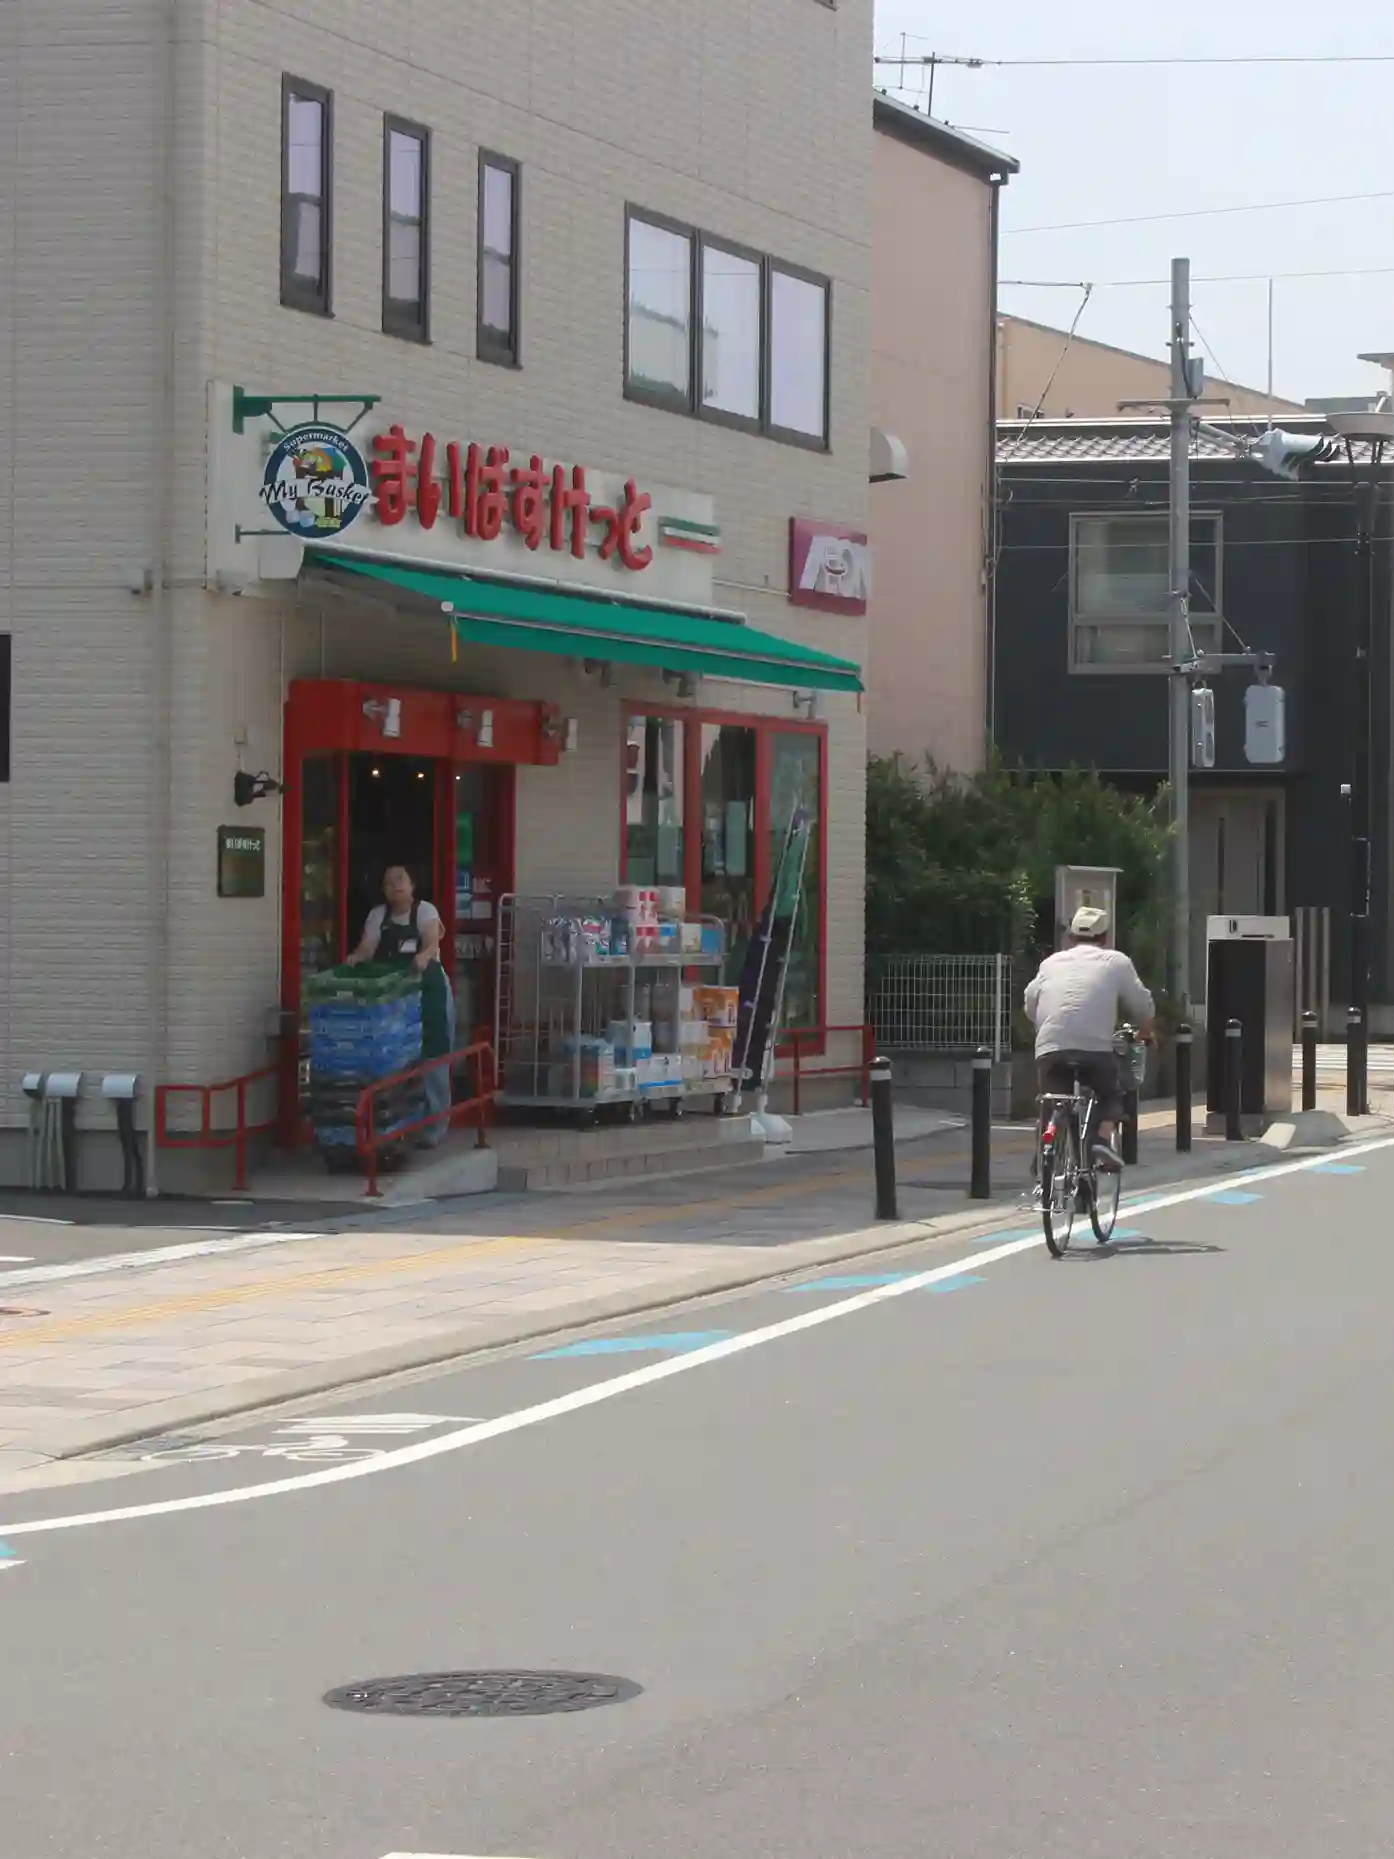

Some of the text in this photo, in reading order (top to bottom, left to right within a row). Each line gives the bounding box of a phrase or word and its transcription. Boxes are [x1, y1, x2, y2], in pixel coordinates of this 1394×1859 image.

[283, 432, 350, 452] Supermarket
[259, 478, 370, 505] My Basket
[372, 424, 654, 571] まいばすけっと
